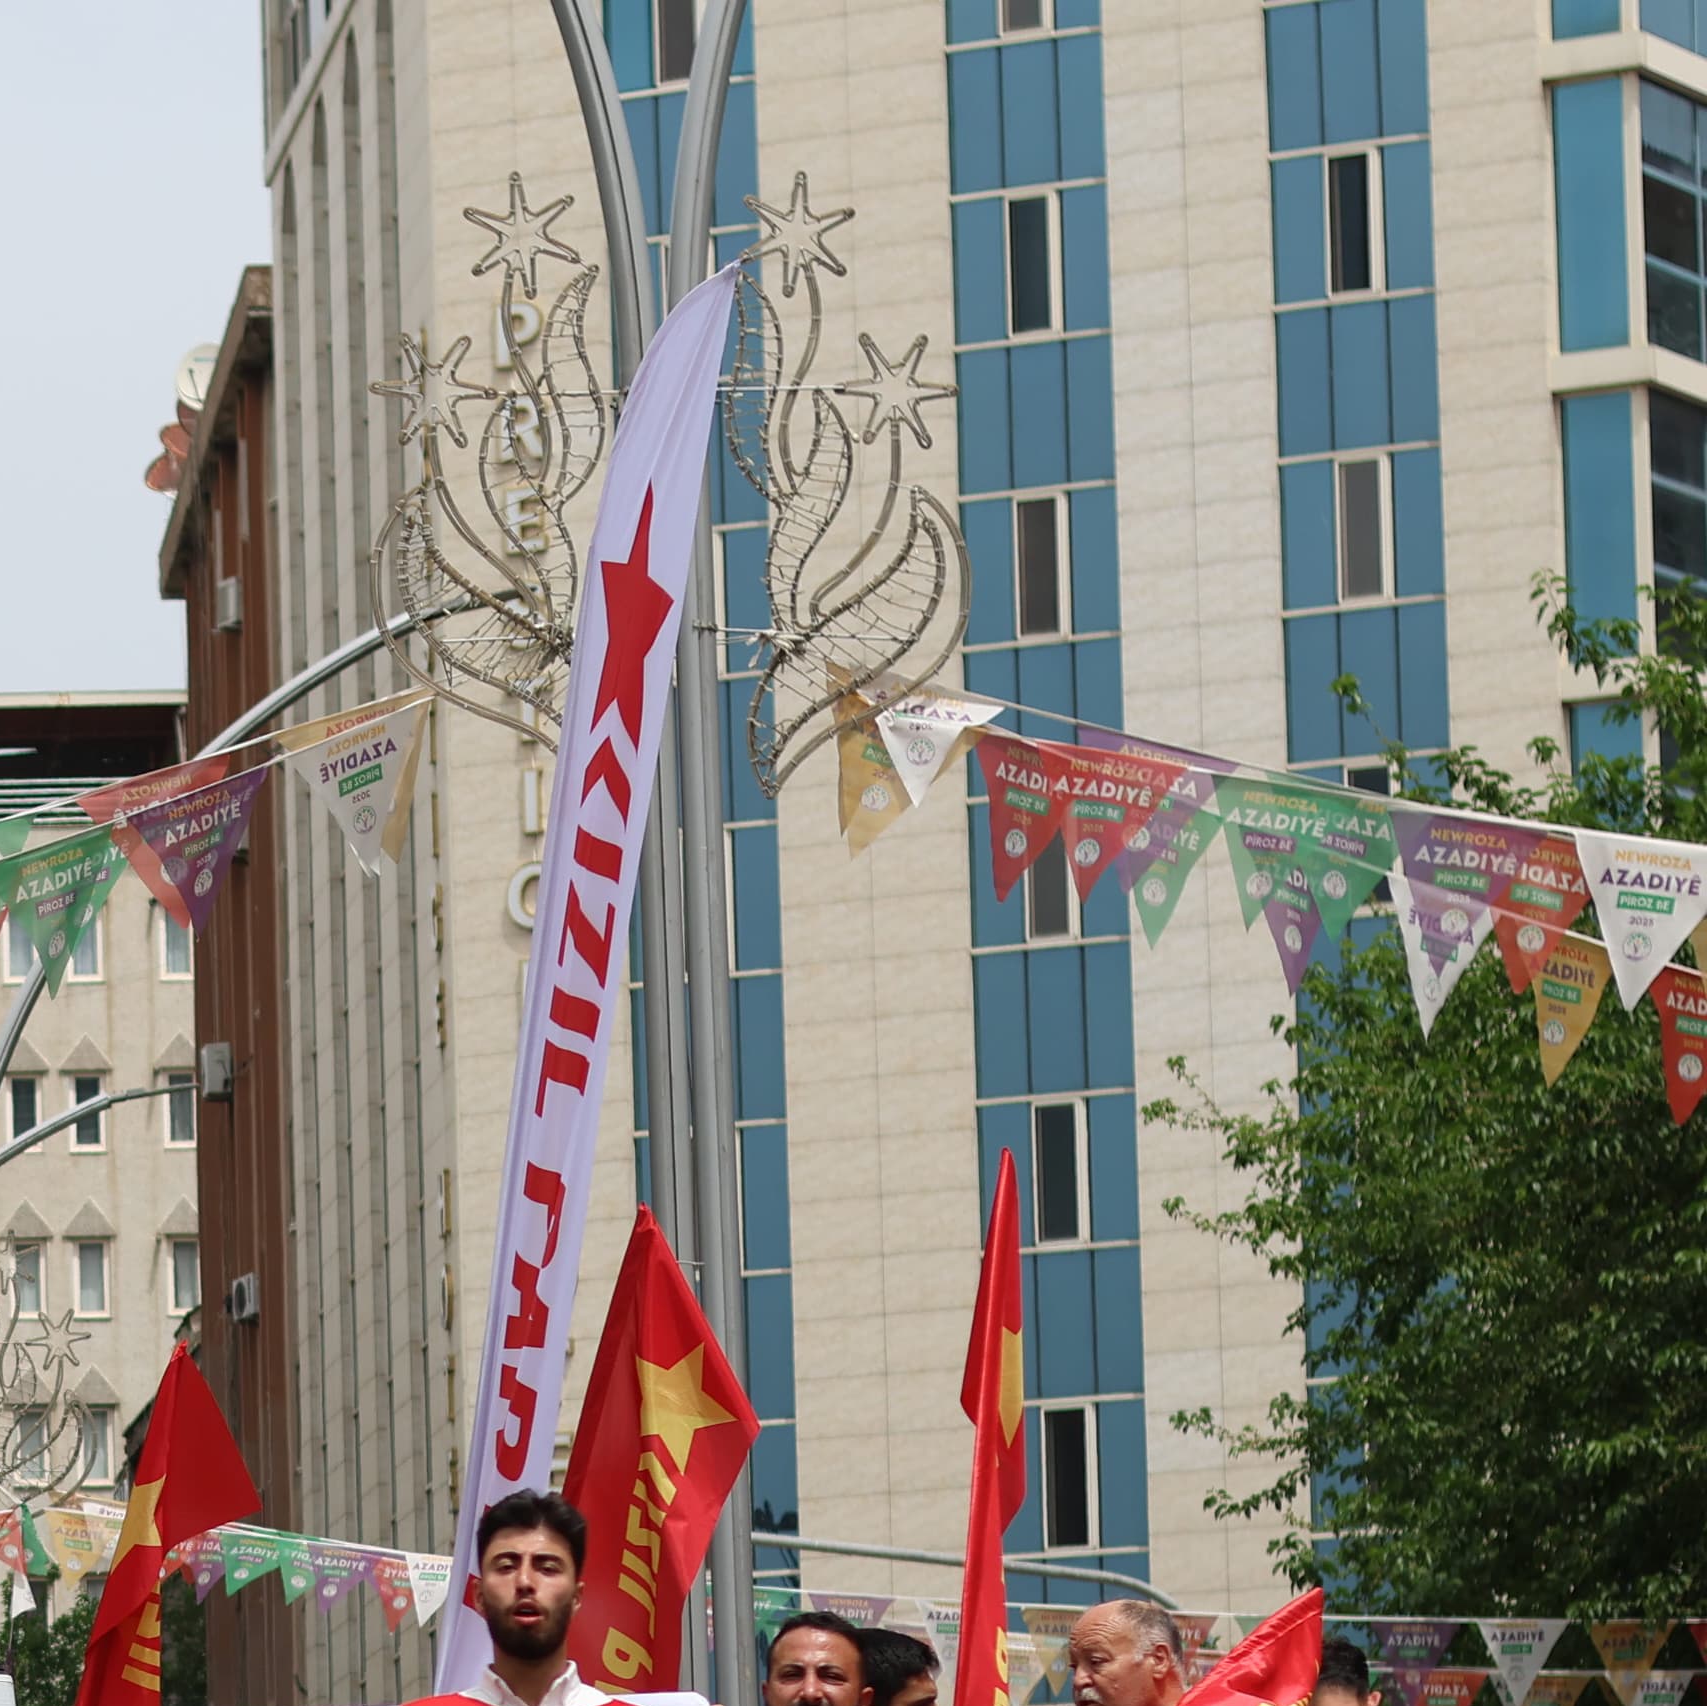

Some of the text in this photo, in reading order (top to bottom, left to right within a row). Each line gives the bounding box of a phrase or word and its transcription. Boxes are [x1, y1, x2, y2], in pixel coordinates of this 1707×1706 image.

[1054, 776, 1153, 808] AZADIYÊ
[164, 799, 242, 848] AZADIYÊ
[1226, 806, 1327, 839] AZADIYÊ
[1430, 828, 1508, 850] NEWROZA
[22, 847, 84, 877] NEWROZA
[1414, 845, 1518, 876] AZADIYÊ
[1615, 849, 1692, 871] NEWROZA
[16, 856, 94, 904] AZADIYÊ
[1600, 867, 1703, 896] AZADIYÊ
[535, 737, 632, 1117] KIZIL
